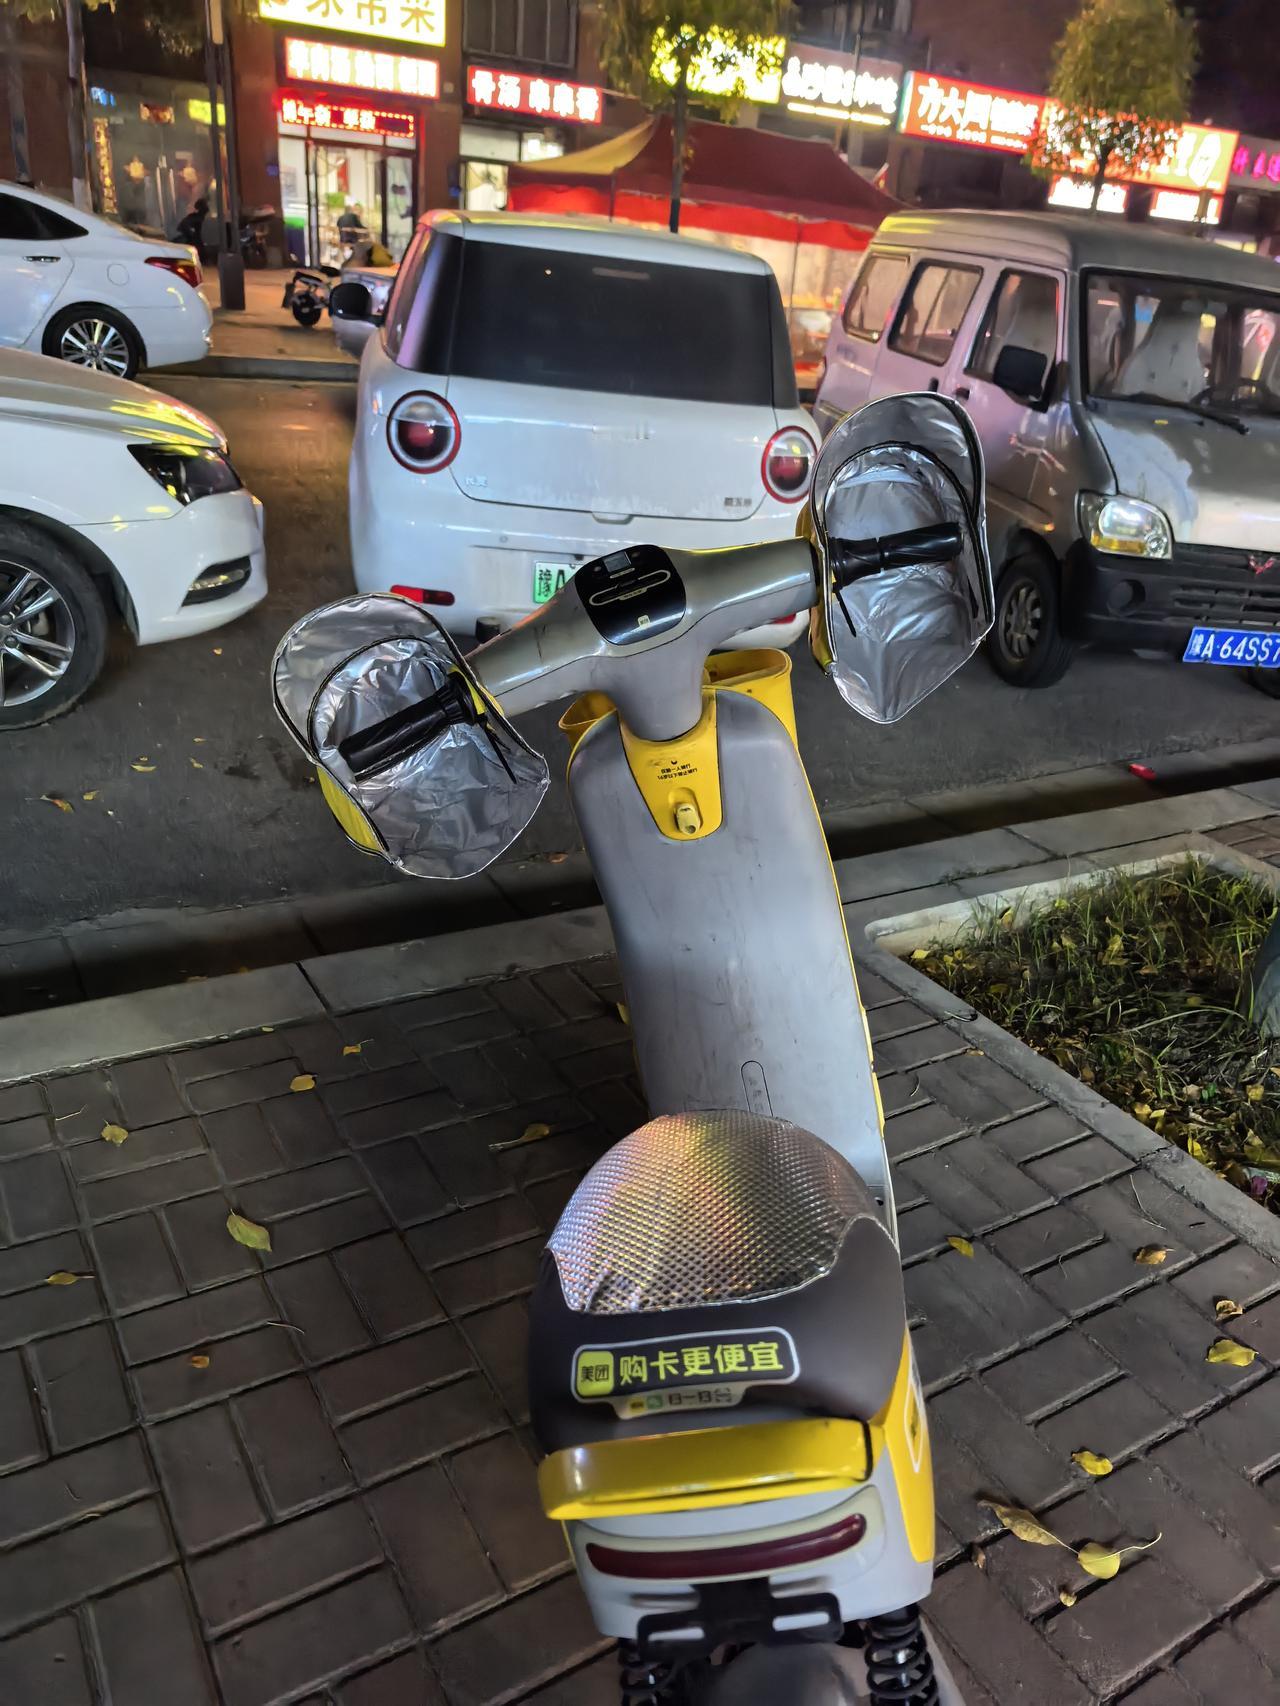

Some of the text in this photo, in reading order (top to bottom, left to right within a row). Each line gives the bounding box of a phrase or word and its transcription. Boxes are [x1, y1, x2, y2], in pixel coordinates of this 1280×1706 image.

[529, 78, 599, 122] 串串香
[580, 1341, 784, 1386] 美团 购卡更便宜
